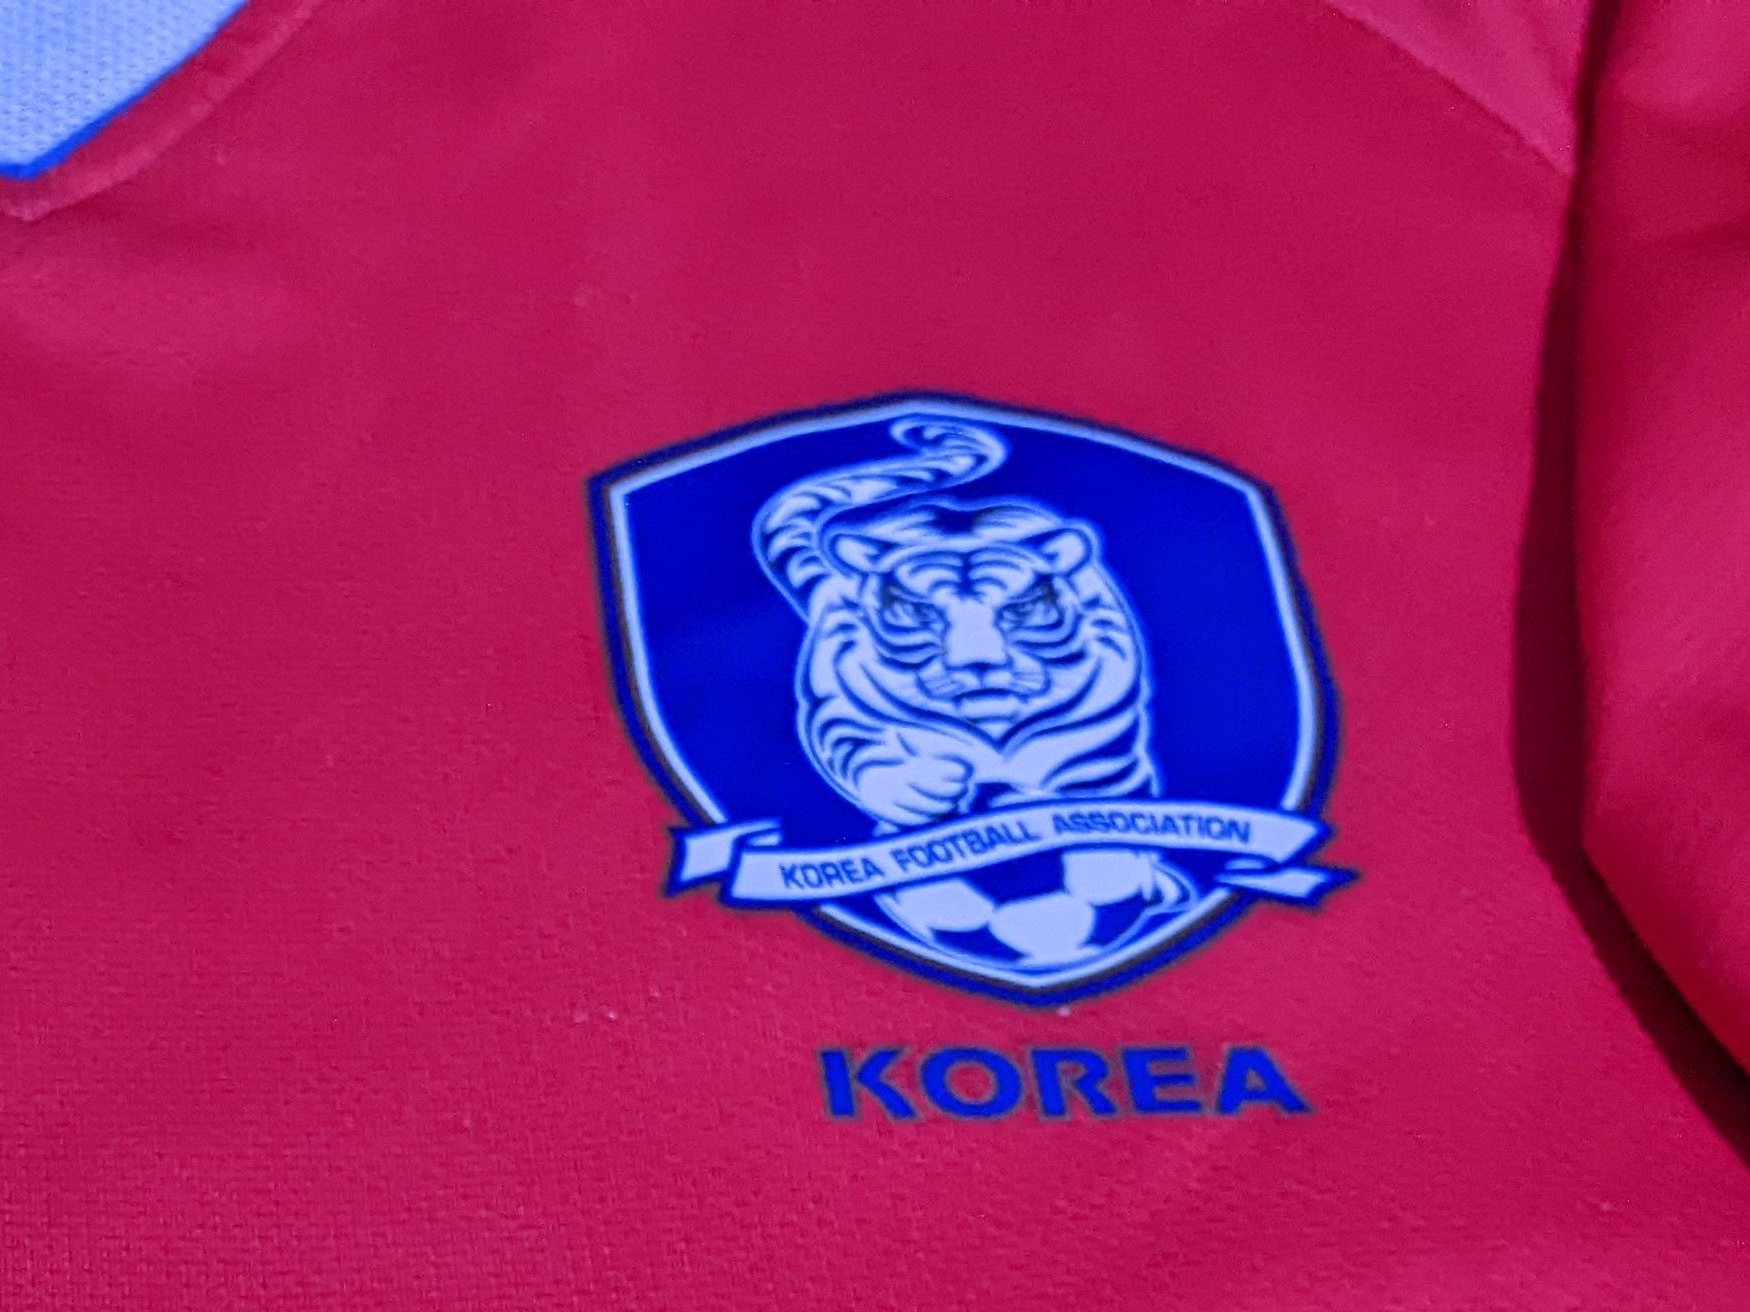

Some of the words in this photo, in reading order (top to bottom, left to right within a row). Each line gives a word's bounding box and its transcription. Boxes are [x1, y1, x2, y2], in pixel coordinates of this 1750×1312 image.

[780, 857, 884, 890] KOREA
[892, 820, 1039, 873] FOOTBALL
[1053, 810, 1250, 844] ASSOCIATION
[819, 1047, 1313, 1120] KOREA
